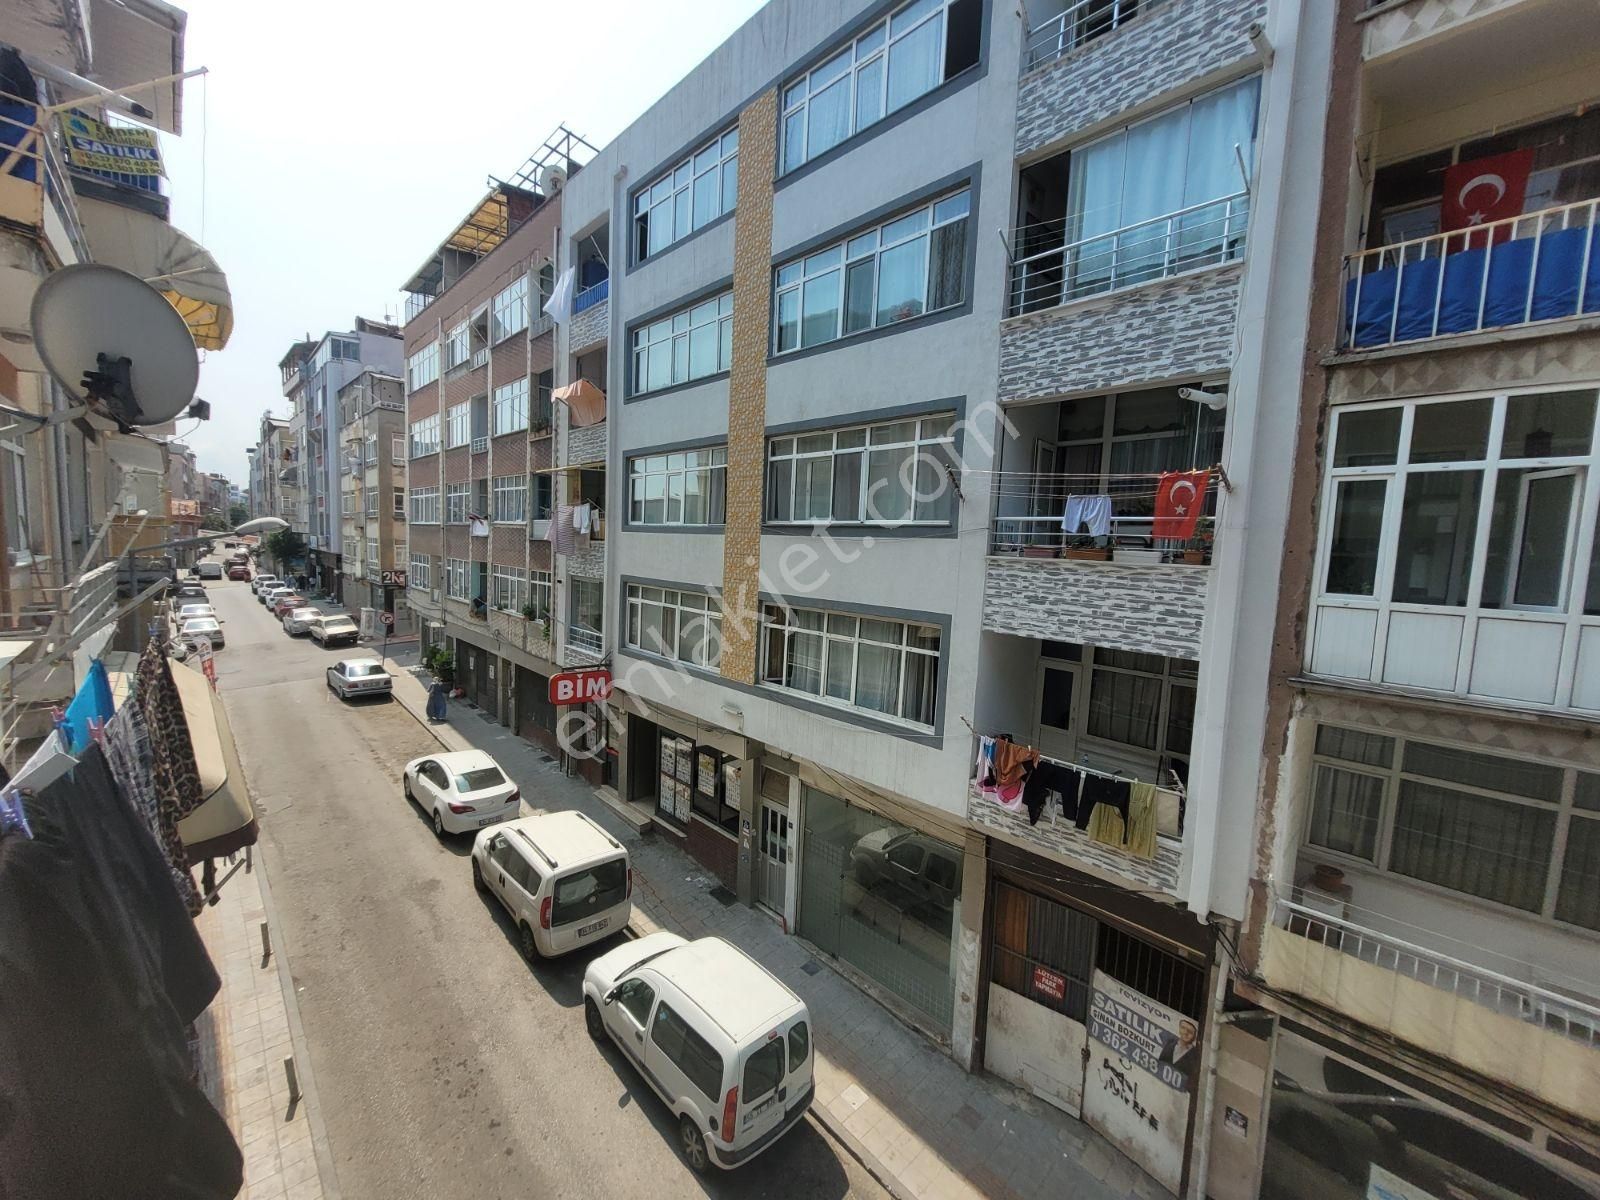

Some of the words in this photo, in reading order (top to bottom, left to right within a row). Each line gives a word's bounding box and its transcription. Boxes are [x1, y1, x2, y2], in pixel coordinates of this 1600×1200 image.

[76, 138, 155, 160] SATILIK
[557, 673, 606, 700] BİM
[1094, 992, 1165, 1044] SATILIK
[1117, 1023, 1156, 1053] BOZKURT
[1091, 1021, 1099, 1037] 0
[1102, 1028, 1129, 1055] 362
[1132, 1047, 1159, 1074] 438
[1162, 1065, 1182, 1088] 00
